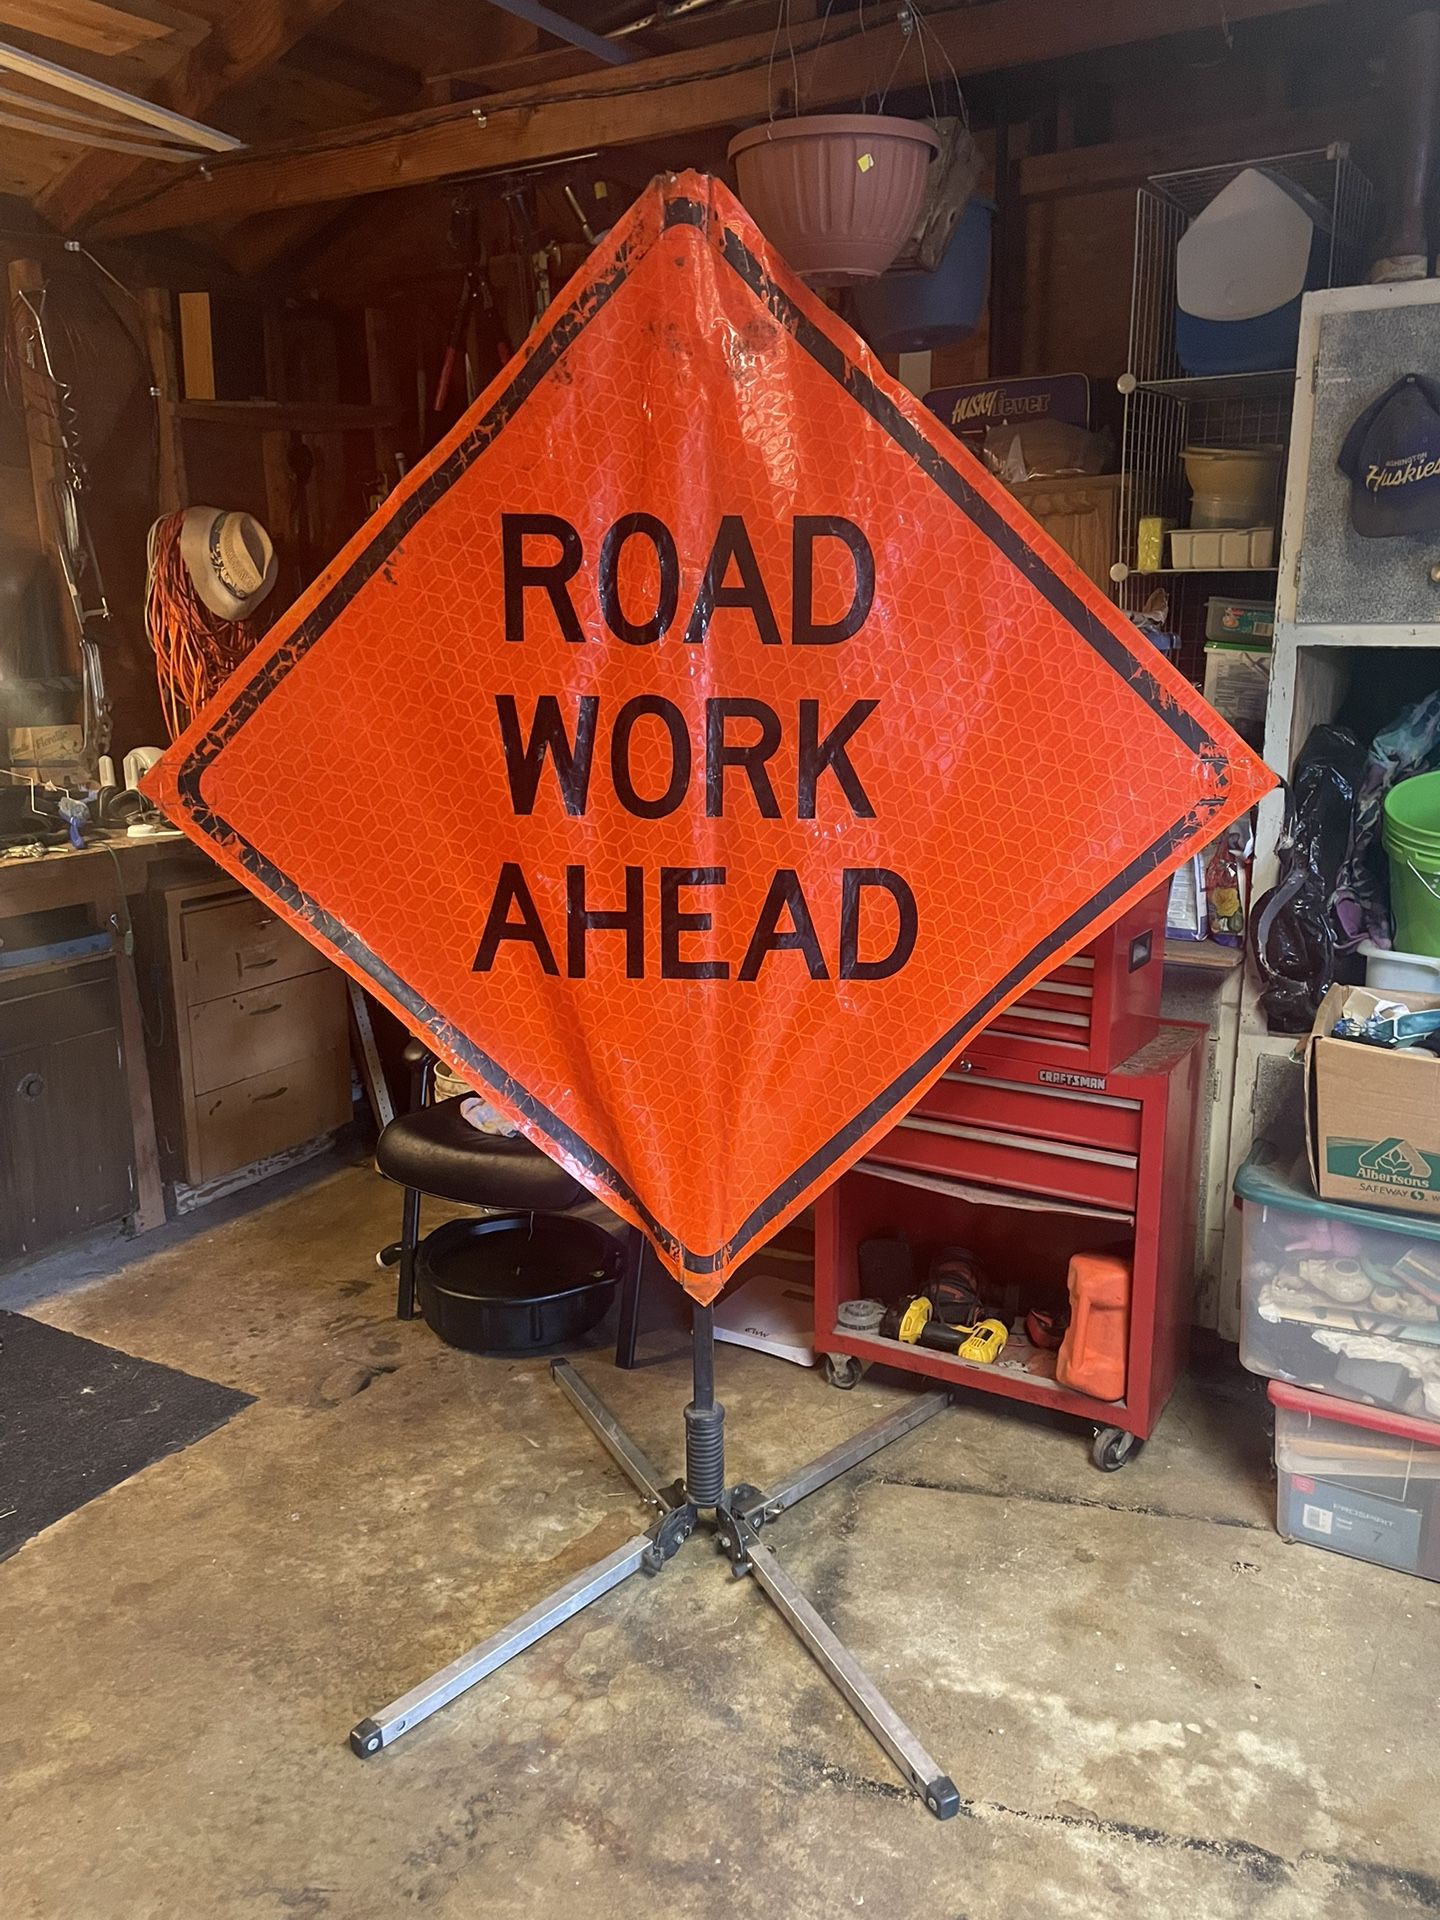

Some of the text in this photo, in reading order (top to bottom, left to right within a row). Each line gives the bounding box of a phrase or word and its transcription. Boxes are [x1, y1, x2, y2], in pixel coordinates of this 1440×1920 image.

[1366, 457, 1440, 492] Huskies
[502, 512, 876, 646] ROAD
[495, 694, 881, 820] WORK
[471, 862, 919, 981] AHEAD
[1039, 1070, 1106, 1090] CRAFTSMAN
[1356, 1167, 1430, 1188] Albertsons
[1360, 1182, 1409, 1197] SAFEWAY
